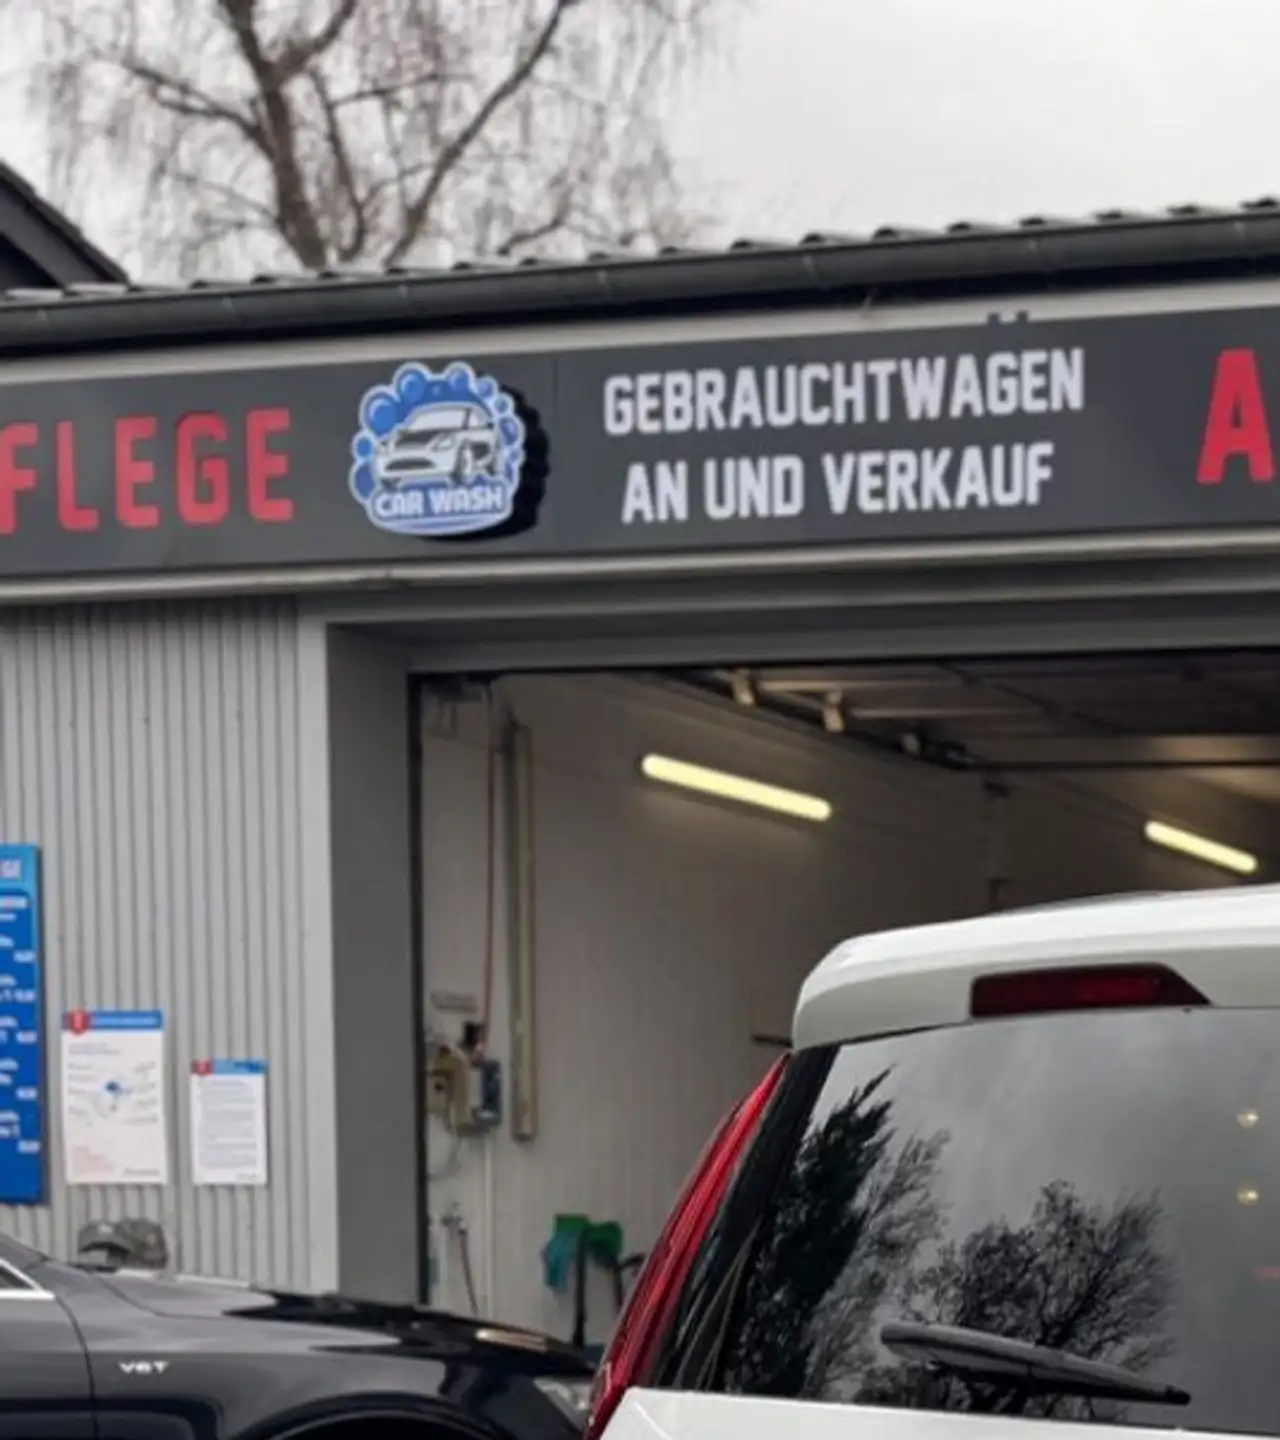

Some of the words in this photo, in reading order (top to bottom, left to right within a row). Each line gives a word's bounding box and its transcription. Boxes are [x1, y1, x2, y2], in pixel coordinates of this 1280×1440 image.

[0, 407, 293, 535] FLEGE
[374, 489, 424, 517] CAR
[428, 485, 503, 514] WASH
[621, 460, 689, 524] AN
[703, 454, 804, 521] UND
[820, 441, 1055, 516] VERKAUF
